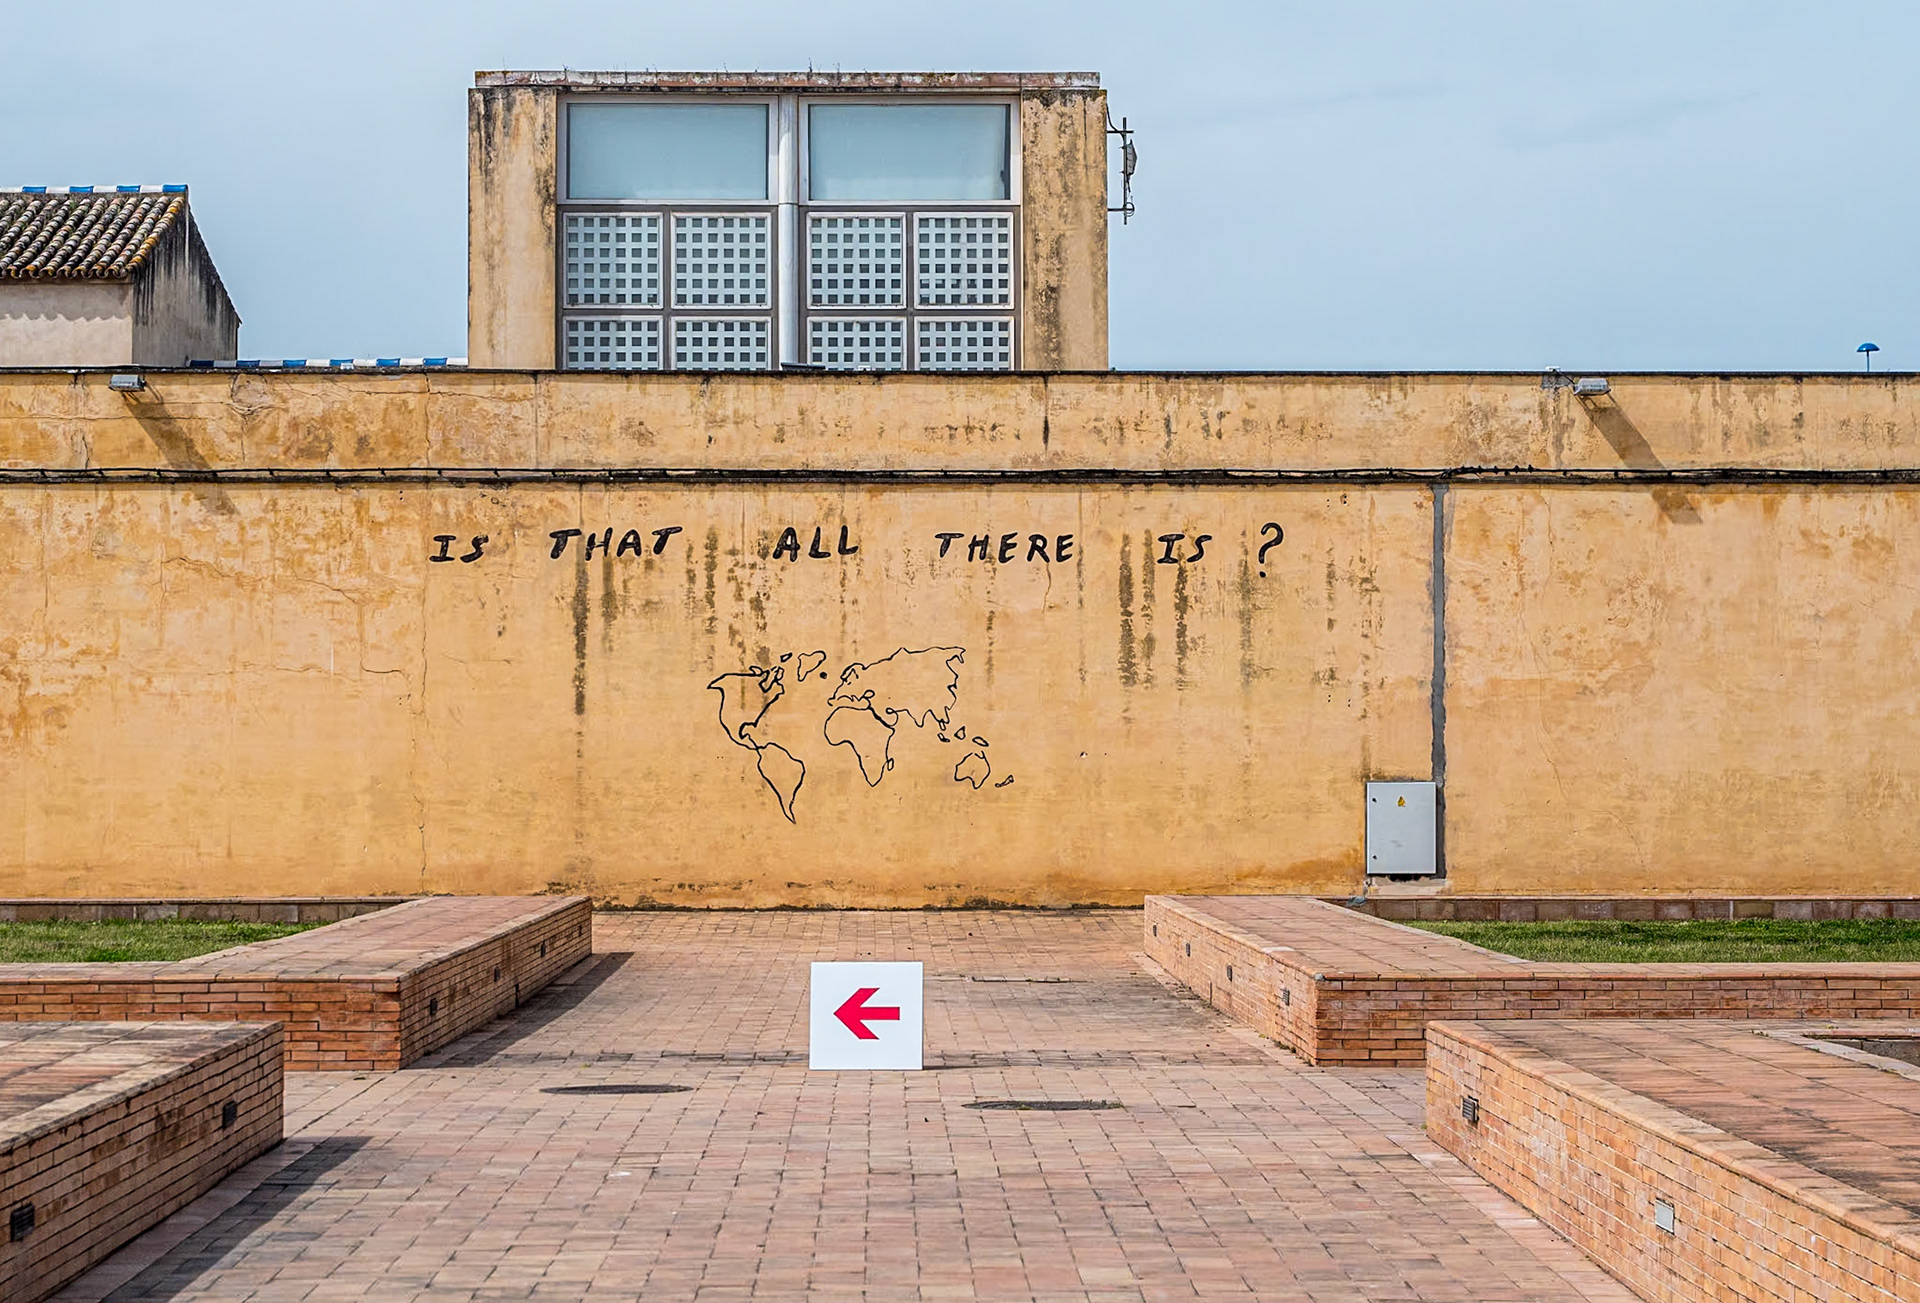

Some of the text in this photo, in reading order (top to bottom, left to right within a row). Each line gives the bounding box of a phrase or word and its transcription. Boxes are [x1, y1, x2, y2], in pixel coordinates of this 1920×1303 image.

[429, 534, 490, 563] IS
[549, 526, 683, 560] THAT
[772, 525, 859, 562] ALL
[934, 532, 1074, 564] THERE
[1157, 533, 1213, 564] IS
